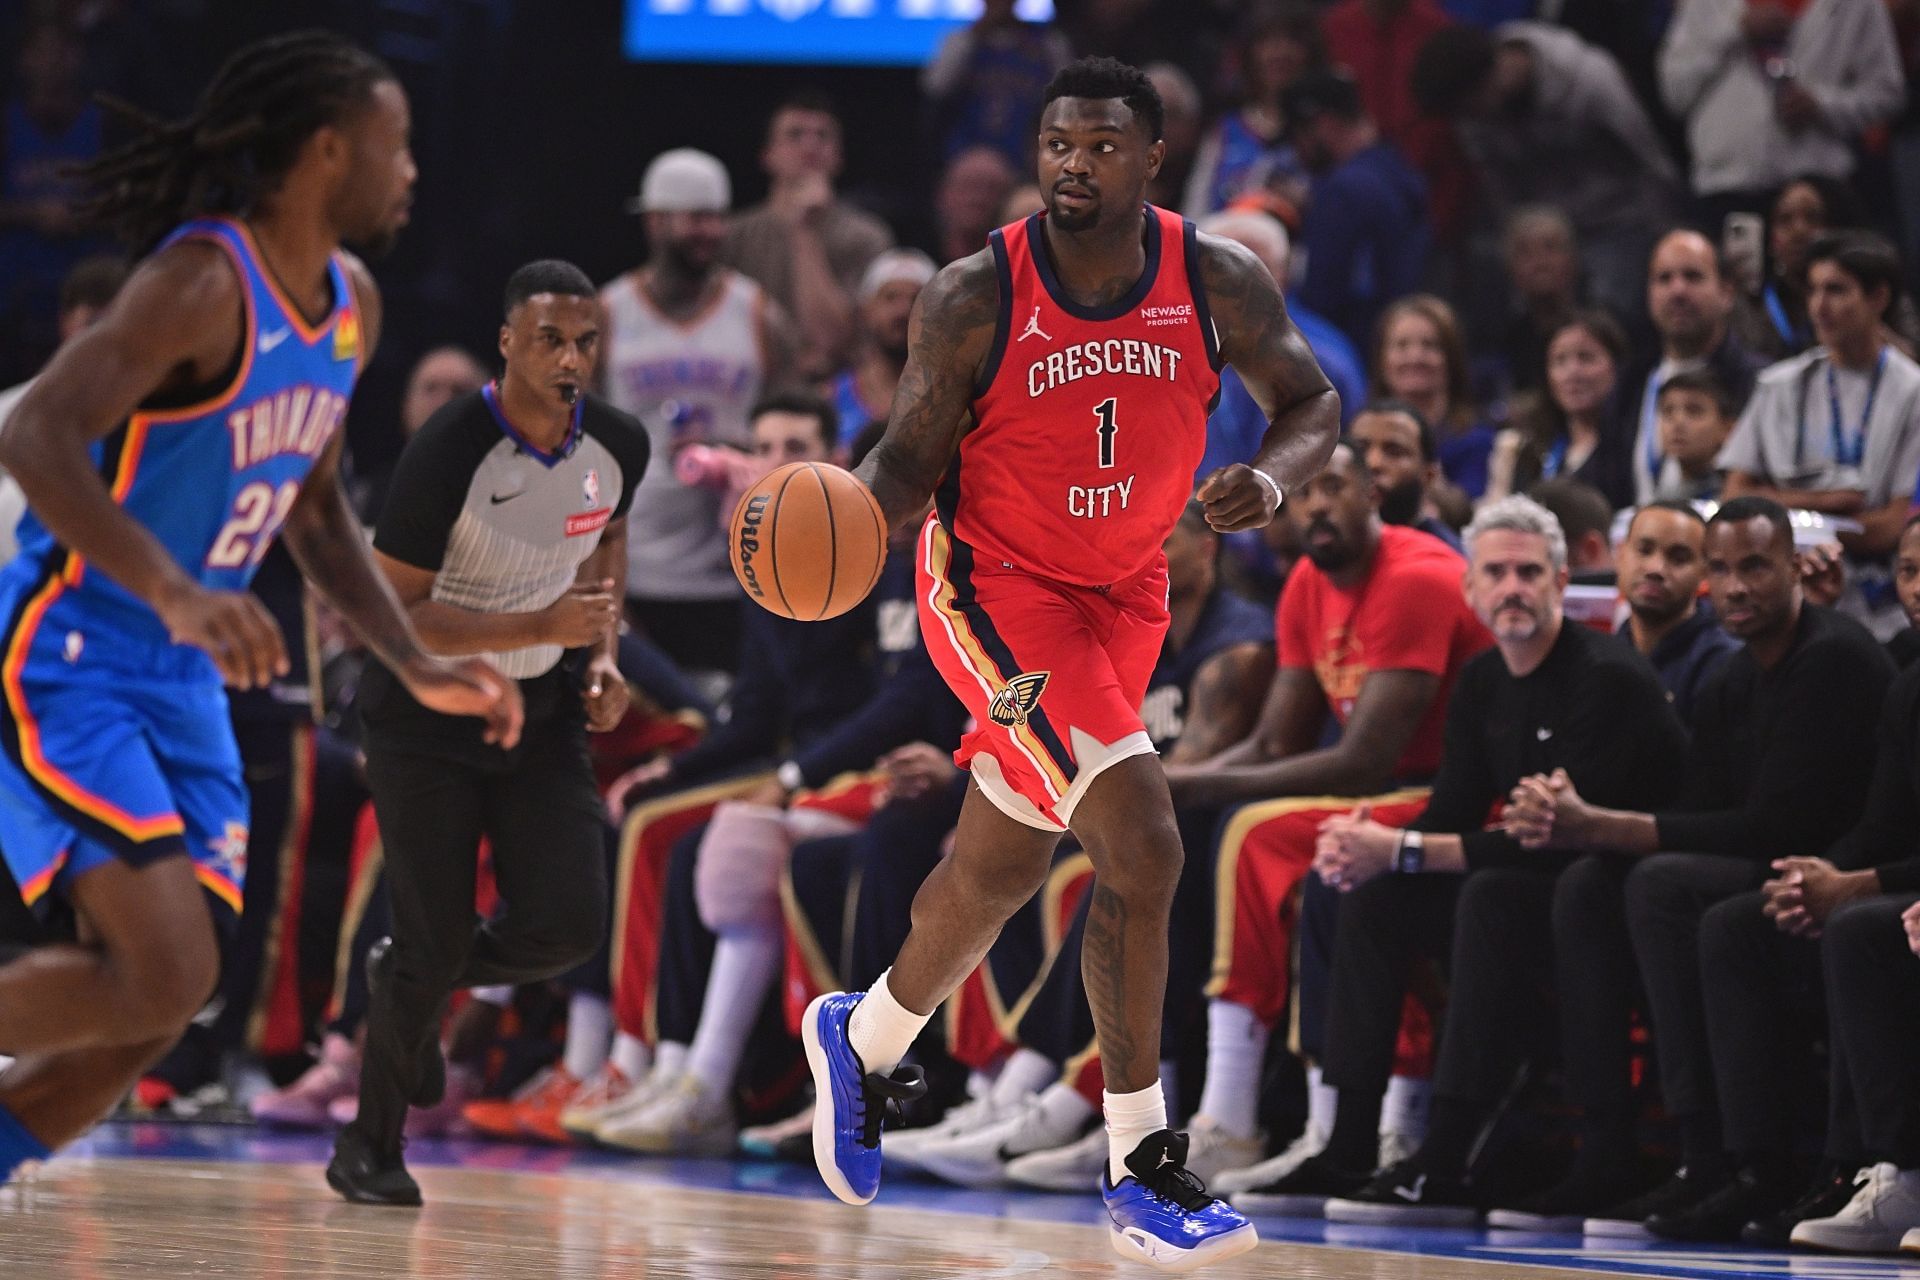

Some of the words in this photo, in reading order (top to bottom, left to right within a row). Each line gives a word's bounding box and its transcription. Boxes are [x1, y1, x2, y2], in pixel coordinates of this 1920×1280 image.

[1141, 304, 1192, 319] NEWAGE
[1147, 317, 1188, 327] PRODUCTS
[1027, 339, 1182, 398] CRESCENT
[1092, 397, 1118, 469] 1
[1067, 473, 1136, 519] CITY
[740, 494, 771, 597] Wilson
